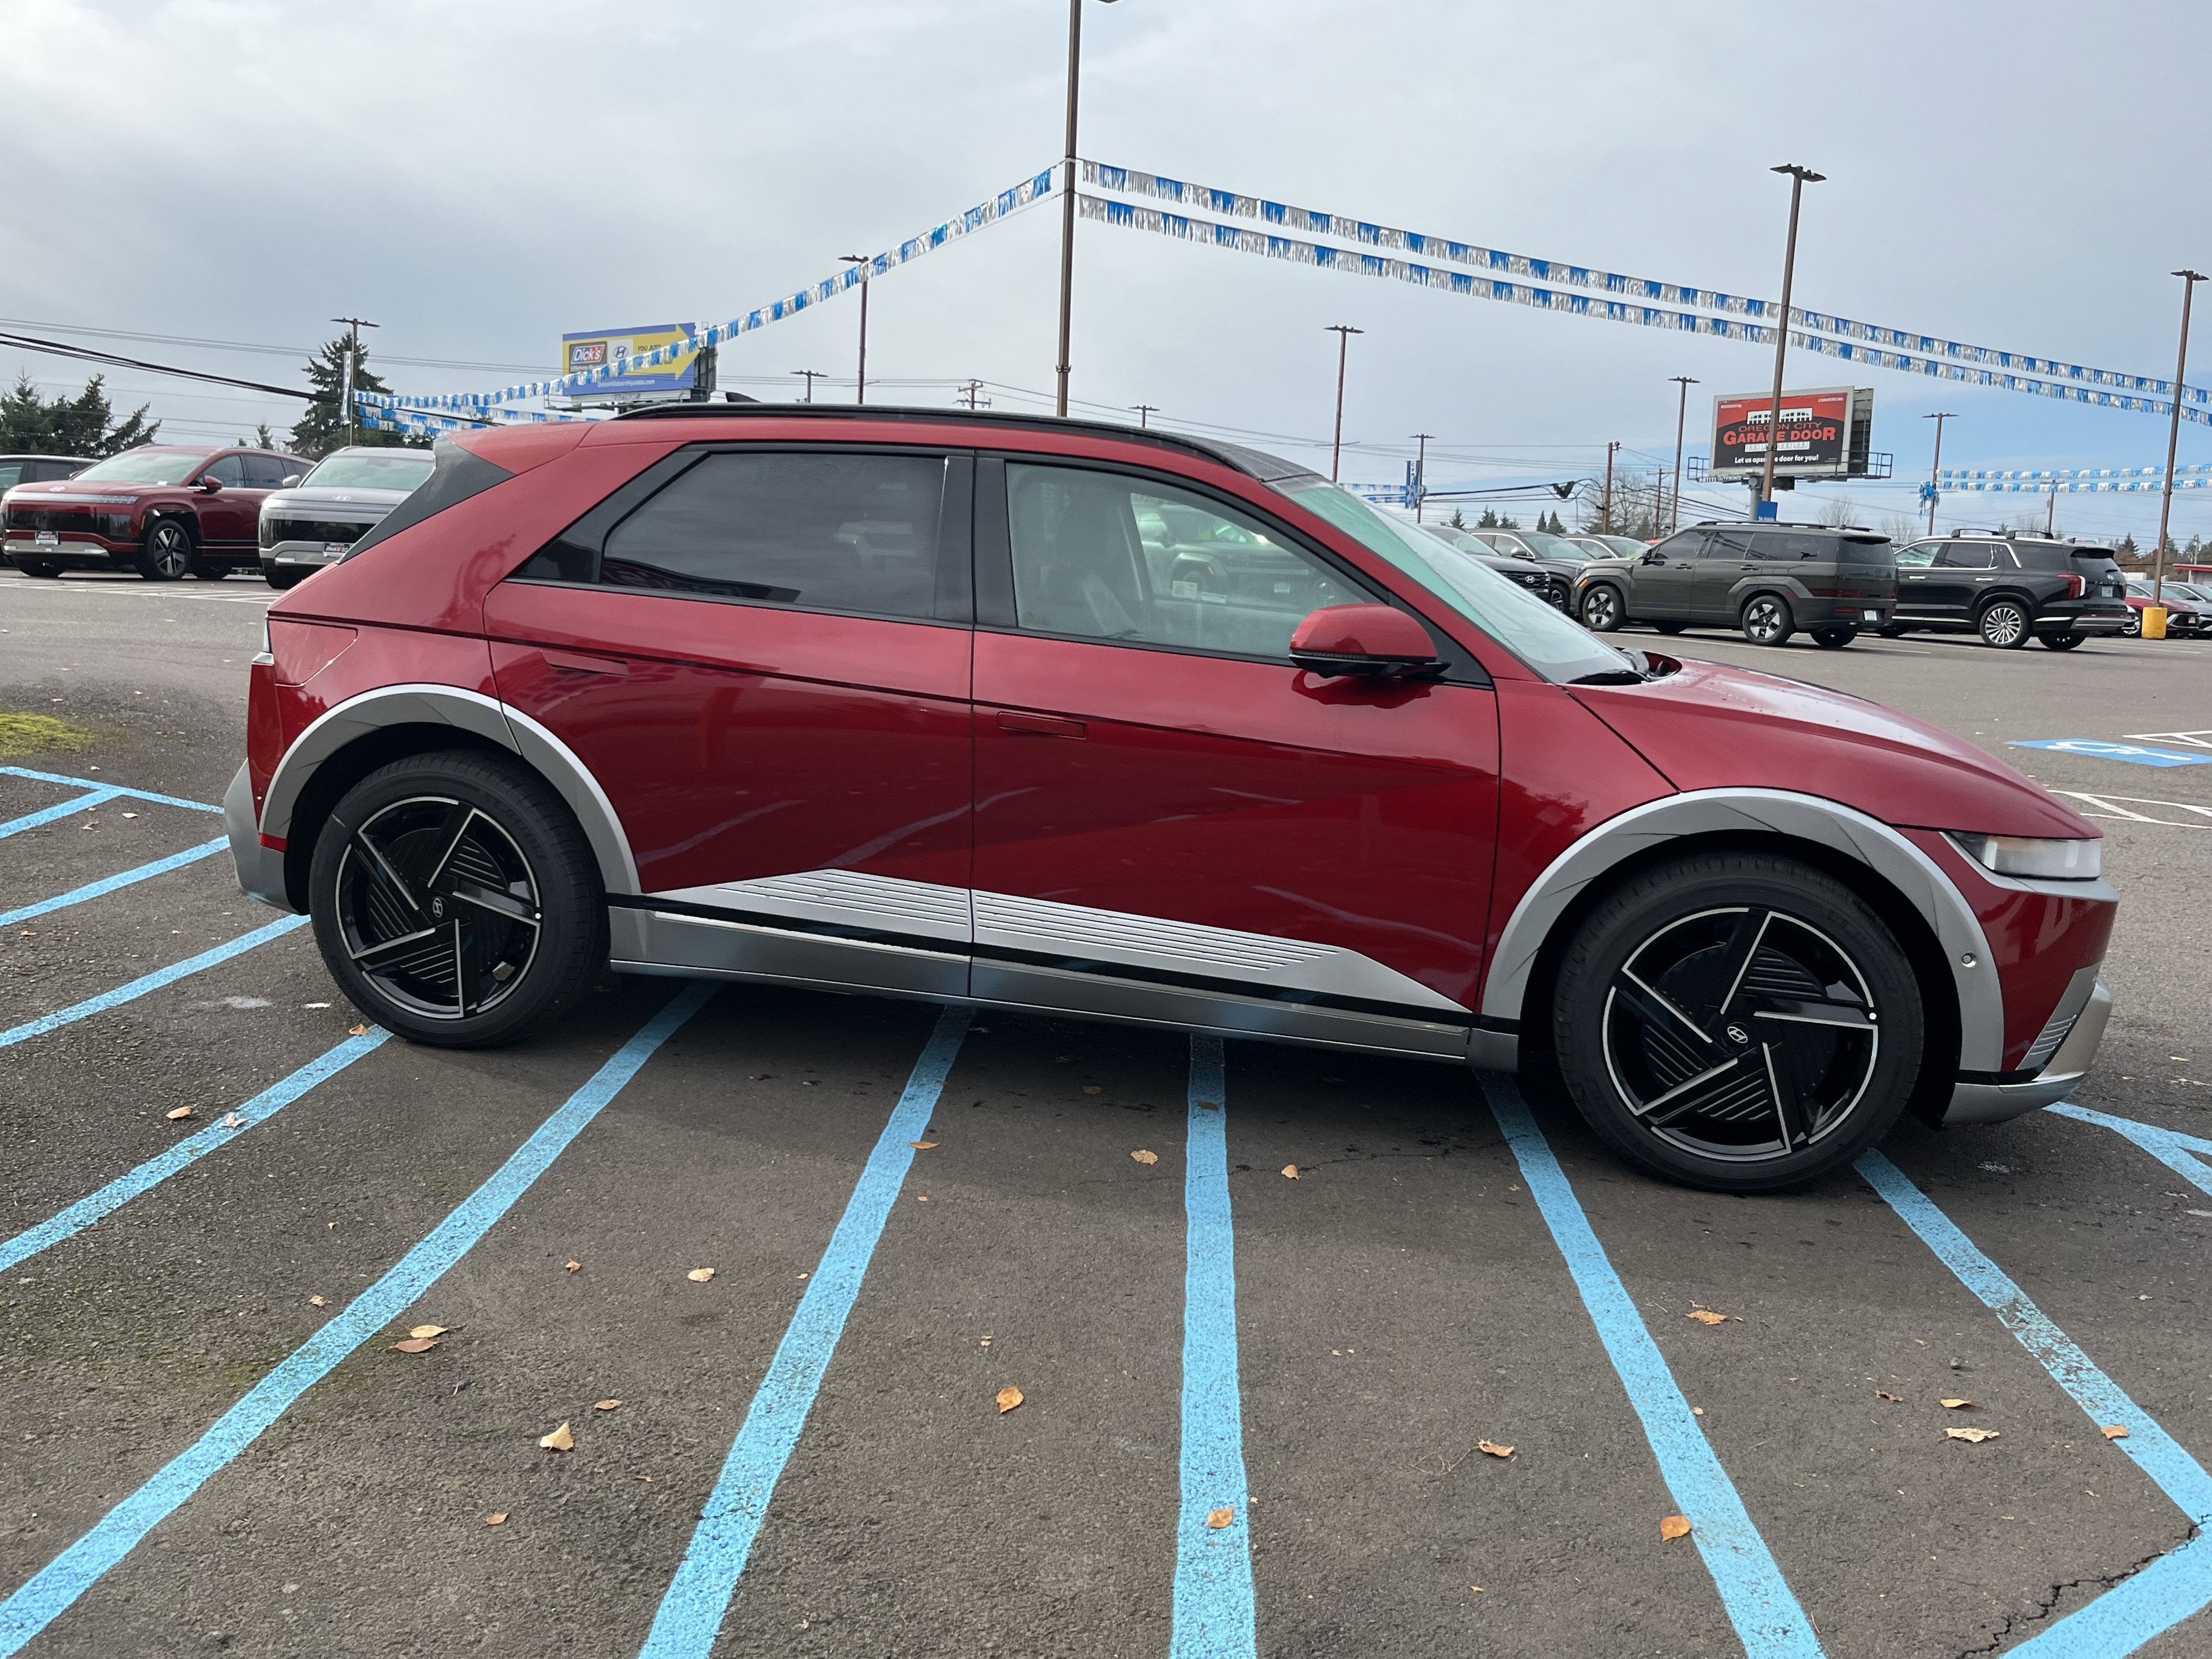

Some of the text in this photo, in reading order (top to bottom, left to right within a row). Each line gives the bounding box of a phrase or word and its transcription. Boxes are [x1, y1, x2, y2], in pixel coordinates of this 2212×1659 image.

[574, 347, 601, 361] Dick's
[1791, 427, 1836, 441] DOOR
[1804, 454, 1819, 463] you!
